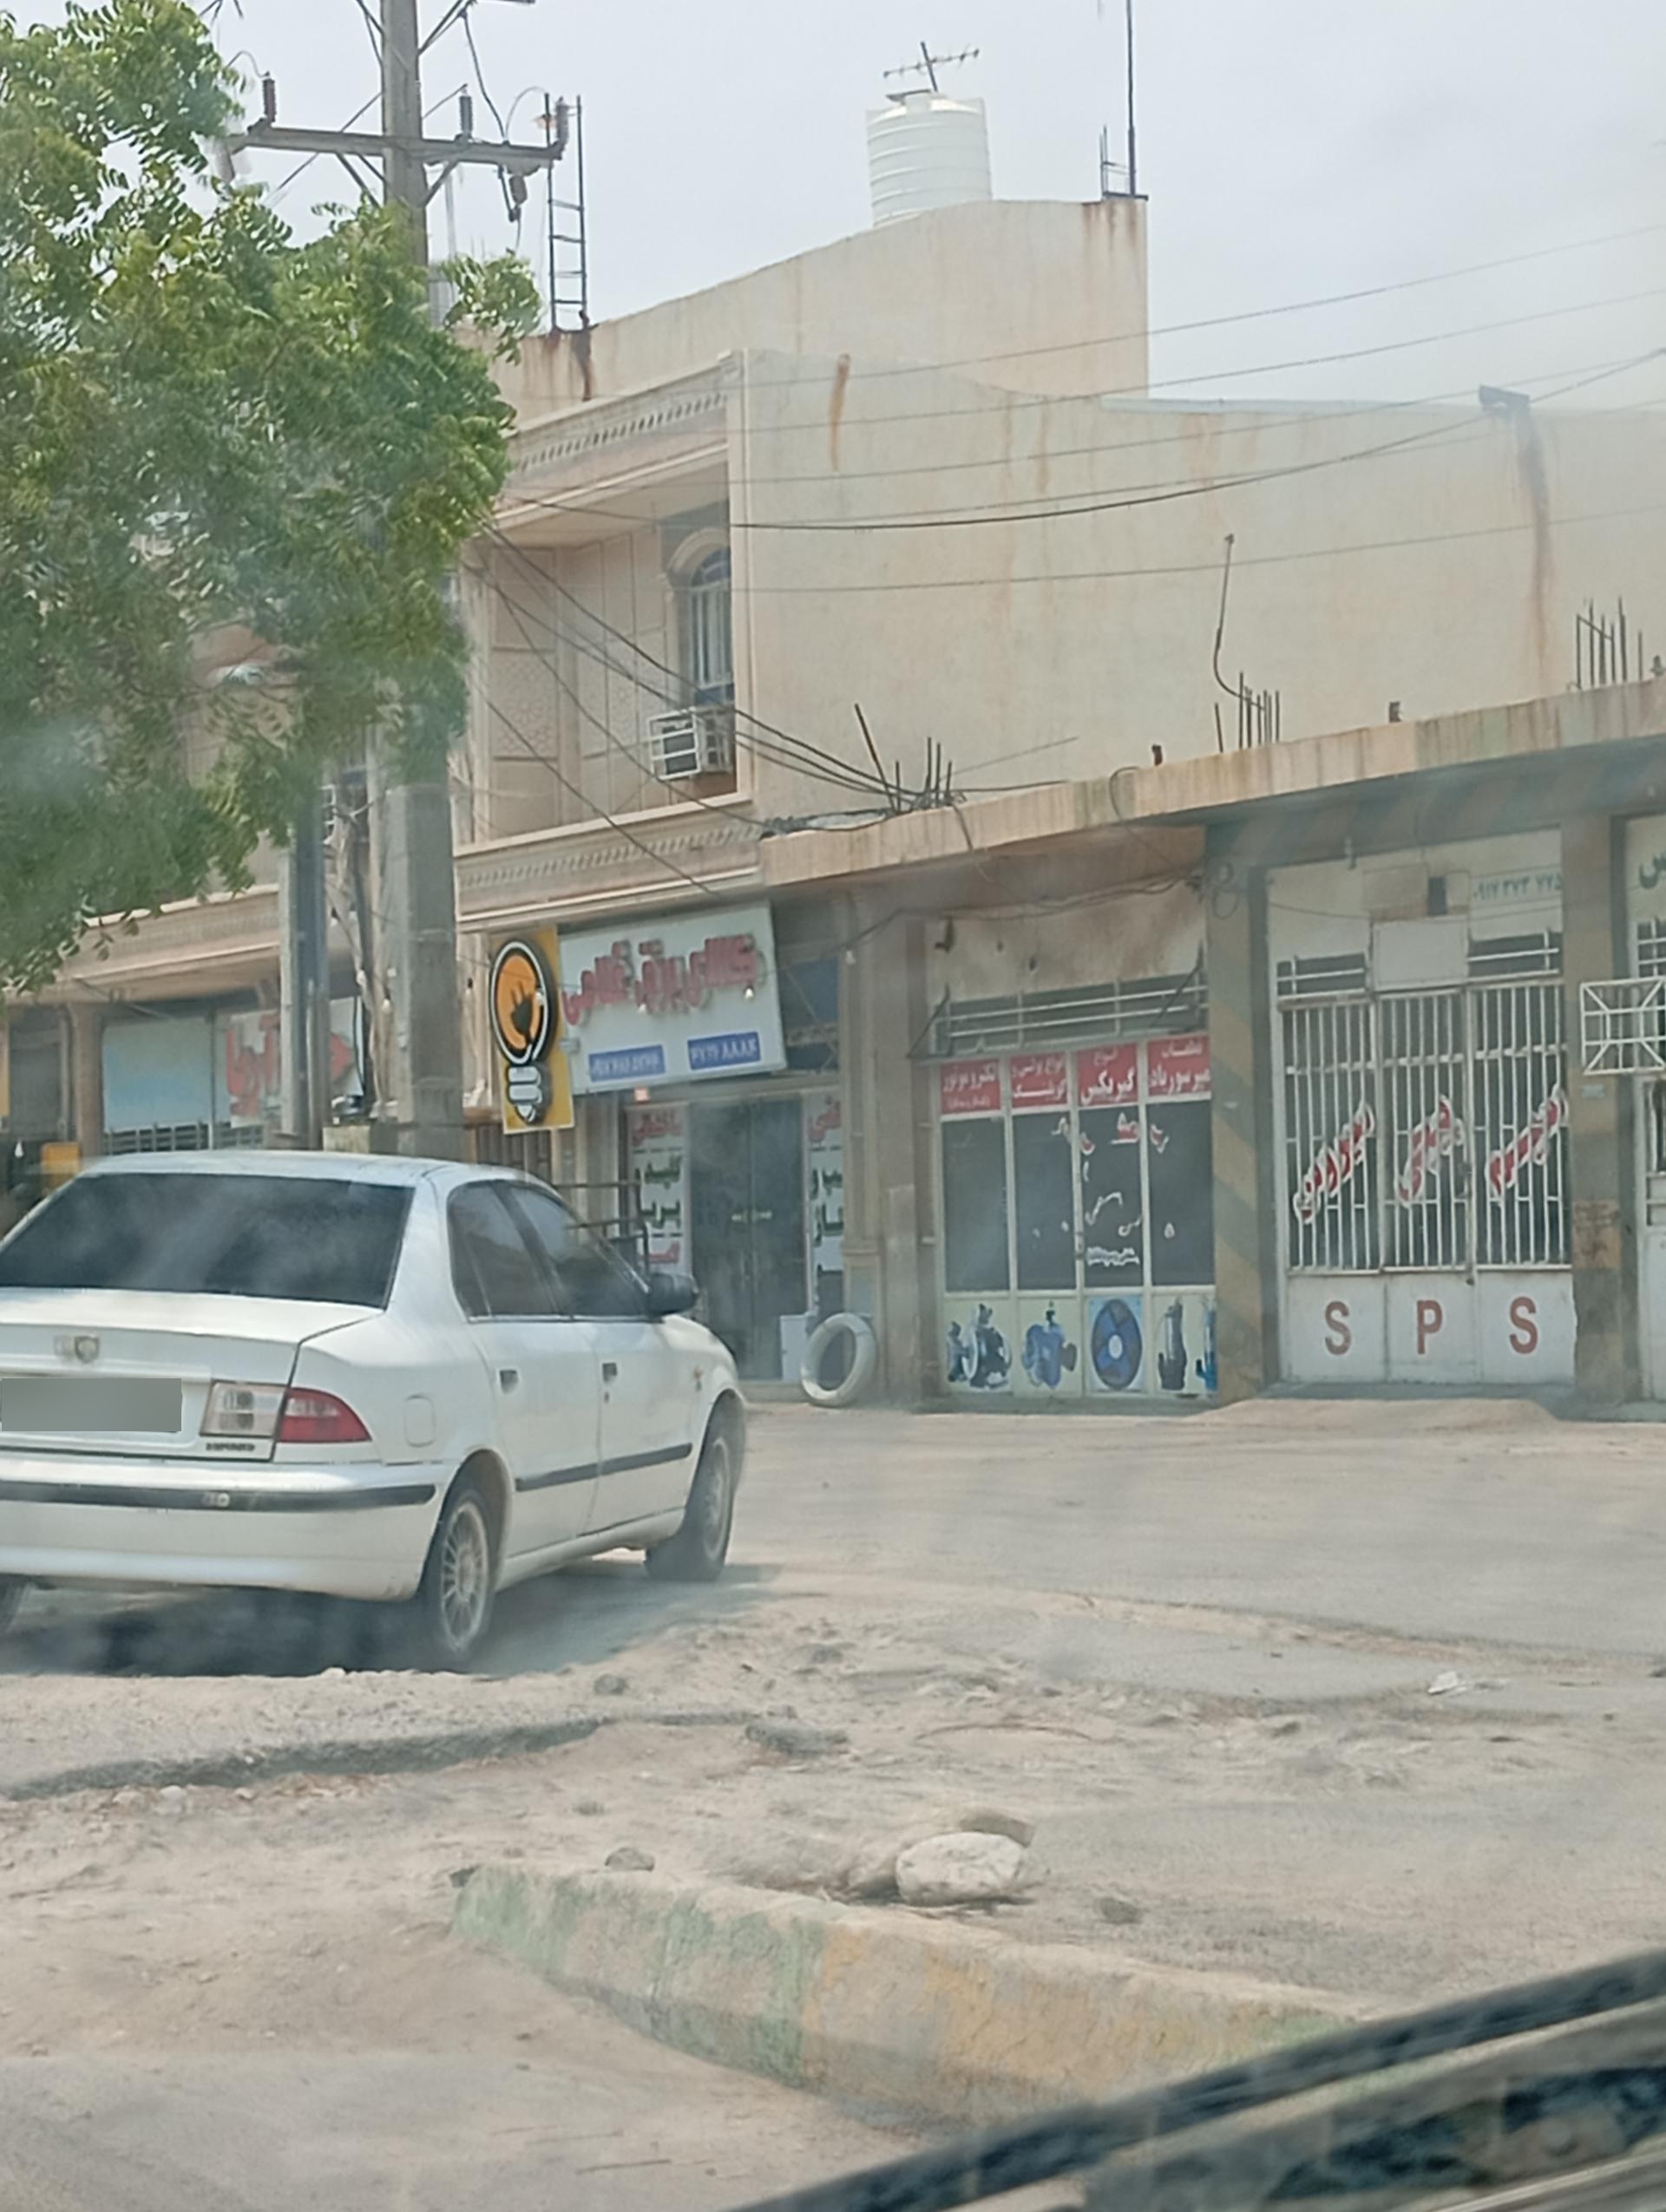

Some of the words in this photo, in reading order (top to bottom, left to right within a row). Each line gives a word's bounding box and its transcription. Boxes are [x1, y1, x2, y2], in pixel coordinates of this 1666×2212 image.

[1325, 1301, 1351, 1355] S
[1416, 1299, 1443, 1355] P
[1509, 1296, 1538, 1355] S
